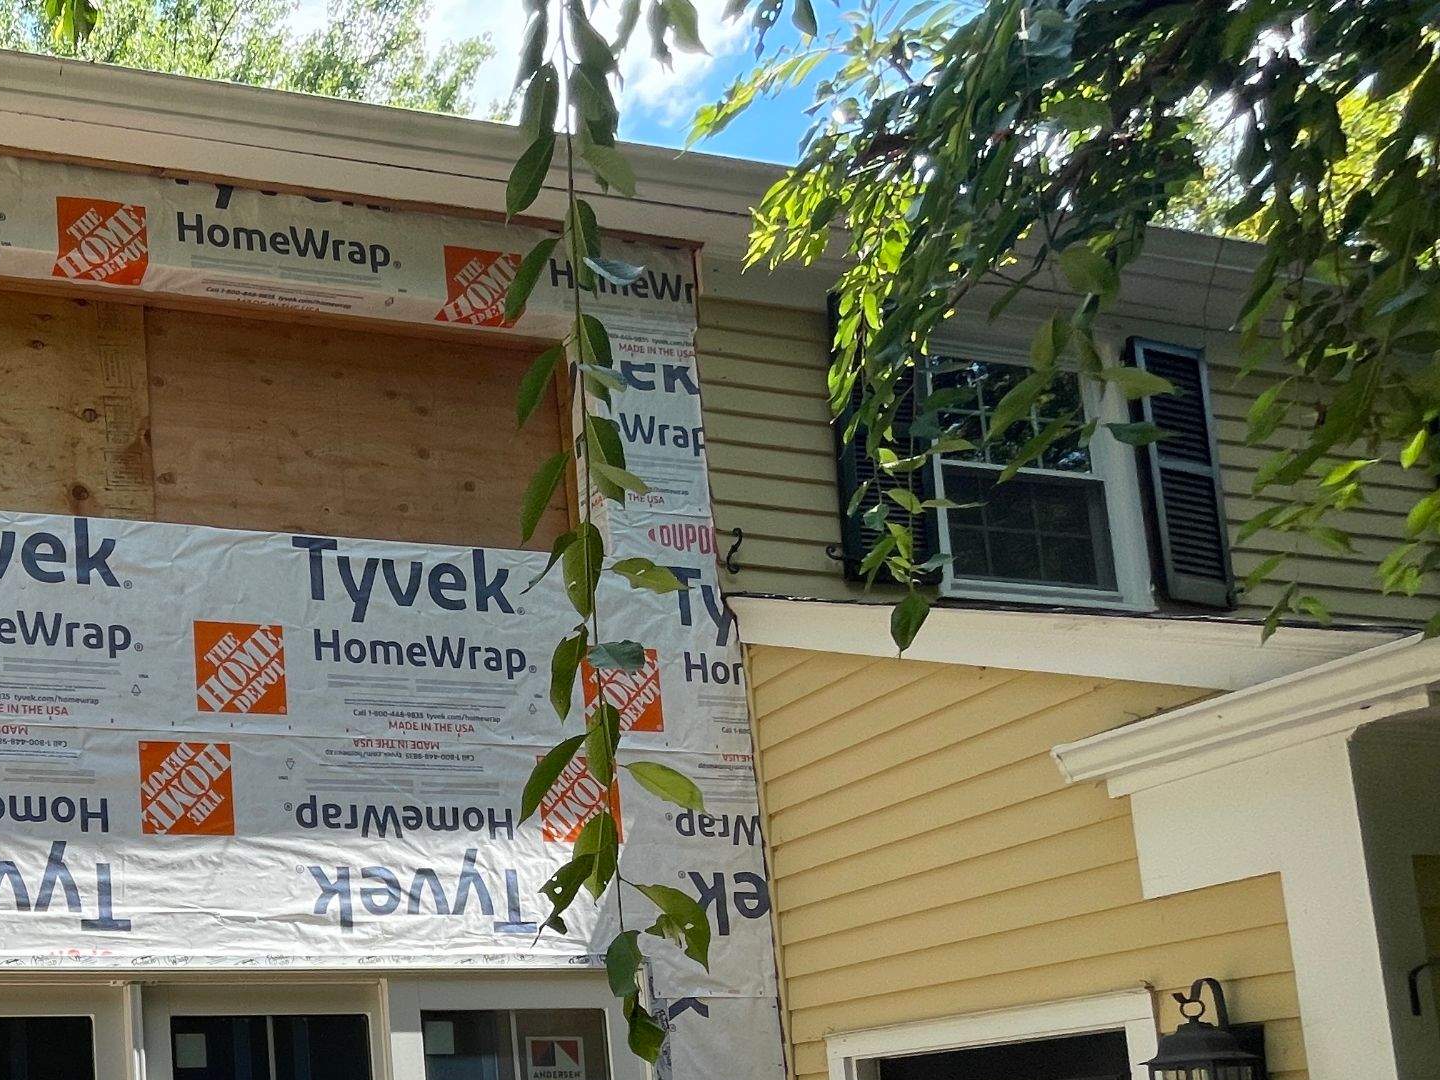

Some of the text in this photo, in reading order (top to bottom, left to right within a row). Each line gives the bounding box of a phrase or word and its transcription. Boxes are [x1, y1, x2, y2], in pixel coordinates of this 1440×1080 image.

[57, 202, 148, 280] HOME
[66, 208, 103, 239] THE
[177, 212, 392, 273] HomeWrap
[90, 240, 148, 283] DEPOT
[292, 536, 517, 622] Tyvek
[196, 624, 285, 713] HOME
[203, 633, 243, 667] THE
[313, 628, 527, 680] HomeWrap
[7, 703, 20, 714] IN
[21, 704, 44, 715] THE
[47, 705, 69, 716] USA
[232, 665, 287, 714] DEPOT
[353, 737, 441, 750] MADE IN THE USA
[389, 720, 476, 734] MADE IN THE USA
[140, 743, 197, 799] DEPOT
[141, 744, 233, 834] HOME
[187, 790, 225, 826] THE
[295, 795, 514, 841] HomeWrap
[305, 848, 538, 935] Tyvek
[533, 1070, 581, 1079] ANDERSEN
